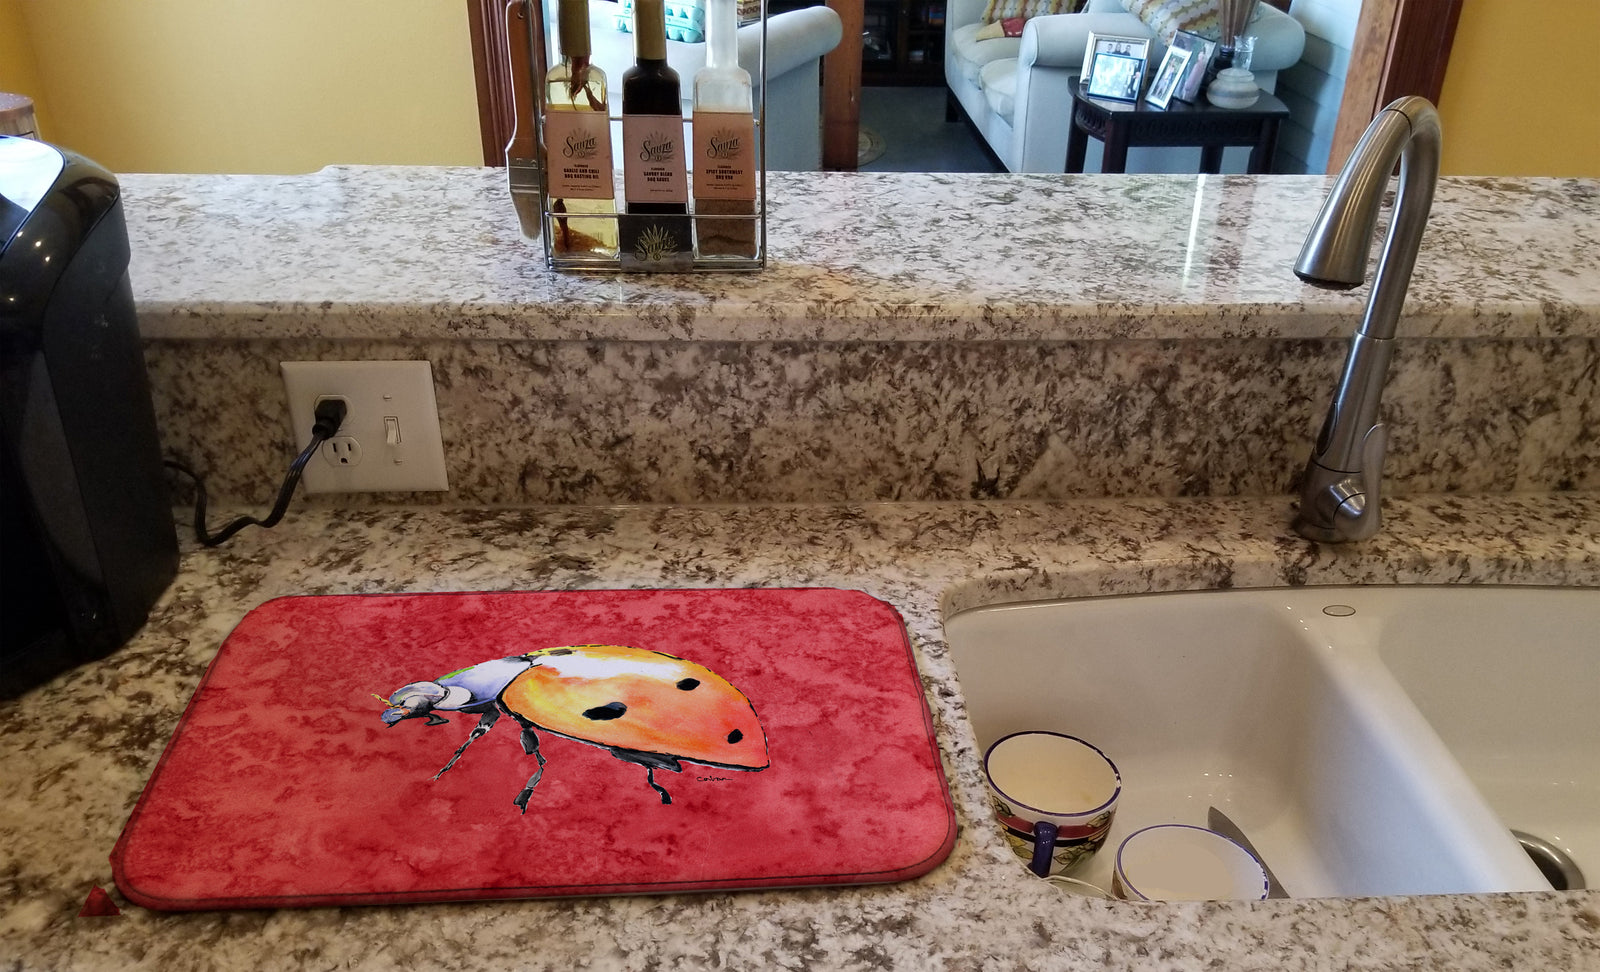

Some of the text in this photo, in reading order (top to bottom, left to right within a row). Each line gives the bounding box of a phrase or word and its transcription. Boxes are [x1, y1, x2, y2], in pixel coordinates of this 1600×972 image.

[563, 136, 597, 158] Sauza
[640, 140, 674, 162] Sauza
[707, 136, 740, 159] Sauza
